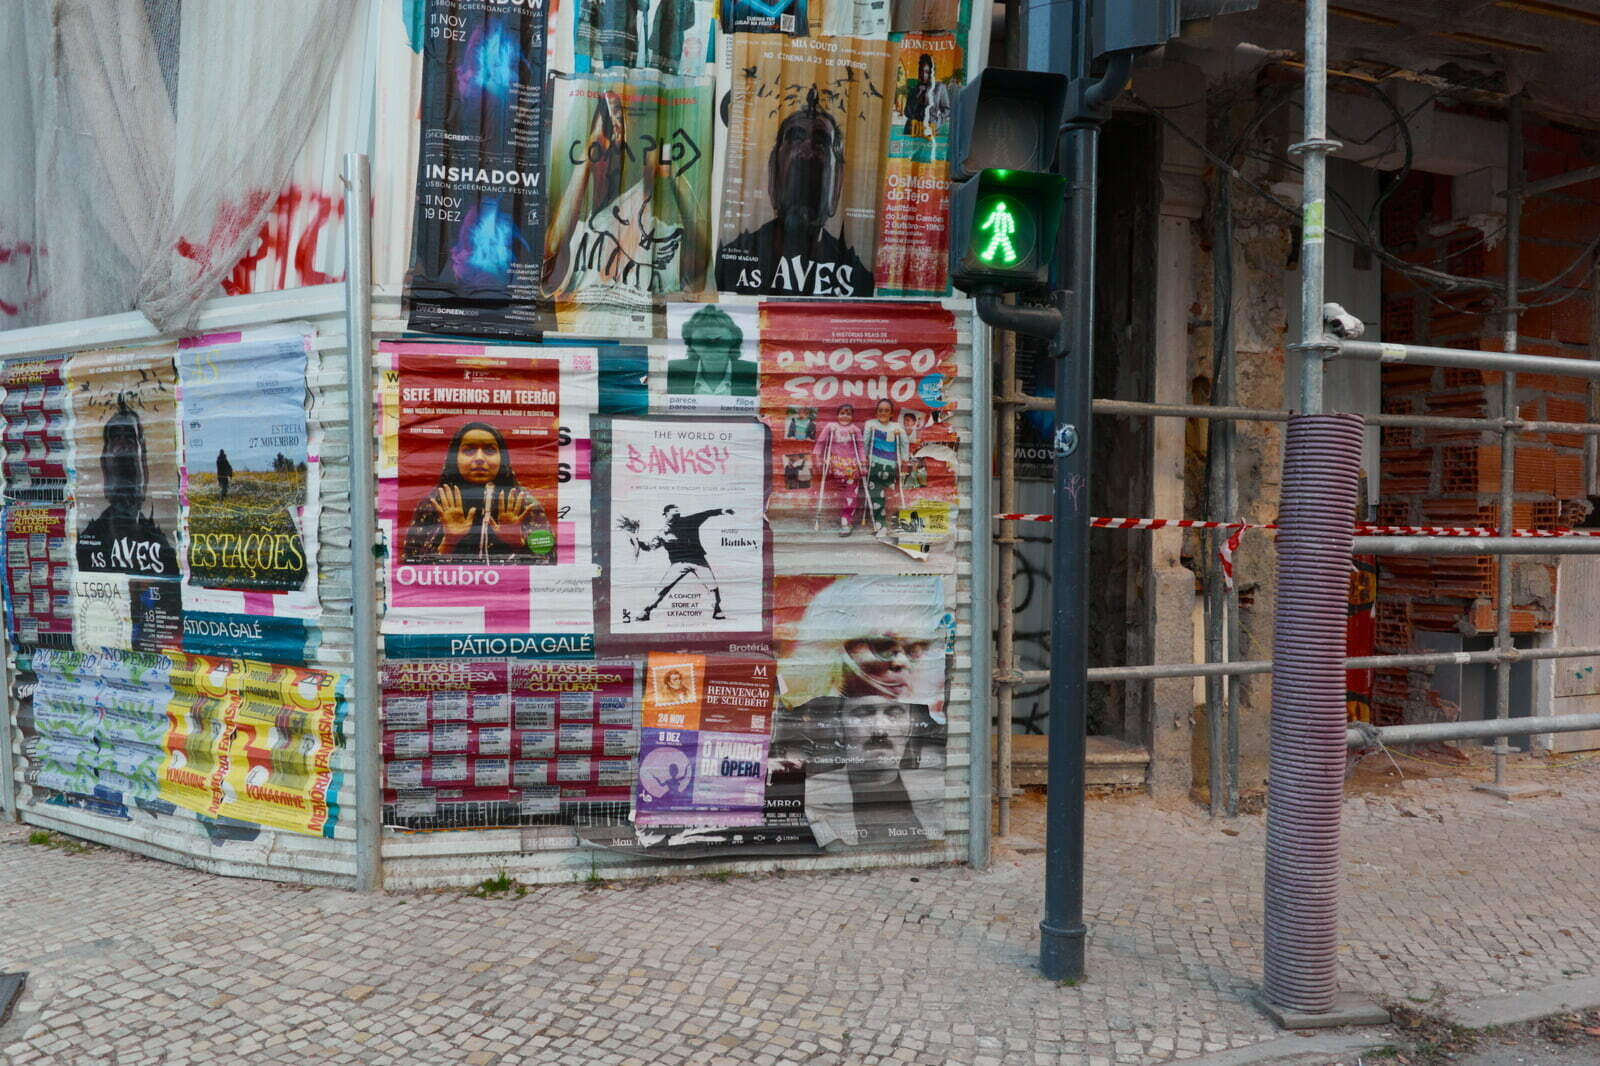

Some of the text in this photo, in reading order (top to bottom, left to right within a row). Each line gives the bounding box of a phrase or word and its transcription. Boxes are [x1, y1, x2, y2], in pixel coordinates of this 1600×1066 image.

[440, 14, 467, 28] NOV
[444, 28, 467, 42] DEZ
[792, 40, 807, 49] MIA
[810, 40, 838, 53] COUTO
[426, 164, 540, 187] INSHADOW
[426, 195, 462, 209] 11 NOV
[903, 189, 929, 204] Tejo
[426, 208, 461, 222] 19 DEZ
[736, 255, 855, 297] AS AVES
[776, 348, 936, 372] O NOSSO
[784, 376, 916, 402] SONHO
[403, 388, 556, 405] SETE INVERNOS EM TEERÃO
[272, 424, 302, 434] ESTREIA
[654, 431, 733, 441] THE WORLD OF
[249, 436, 299, 449] 27 NOVEMBRO
[625, 443, 731, 475] BANKSY
[721, 537, 757, 550] Banksy
[91, 536, 165, 574] AS AVES
[191, 525, 304, 578] ESTAÇÕES
[396, 567, 500, 586] Outubro
[76, 582, 122, 600] LISBOA
[183, 616, 211, 635] ÁTIO
[211, 622, 229, 637] DA
[229, 620, 263, 639] GALÉ
[452, 633, 592, 656] PÁTIO DA GALÉ
[729, 644, 769, 653] Brotéria
[103, 648, 172, 670] NOVEMBRO
[400, 663, 471, 674] AULAS DE
[529, 665, 598, 674] AULAS DE
[400, 672, 497, 682] AUTODEFESA
[530, 674, 624, 683] AUTODEFESA
[400, 682, 477, 691] CULTURAL
[529, 683, 604, 692] CULTURAL
[708, 686, 769, 699] REINVENÇÃO
[707, 696, 768, 708] DE SCHUBERT
[315, 703, 336, 771] FANTASMA
[667, 732, 681, 742] DEZ
[703, 740, 763, 761] O MUNDO
[701, 756, 761, 778] DA ÓPERA
[246, 783, 306, 809] YONAMINE
[888, 828, 908, 837] Mau
[612, 838, 633, 847] Mau
